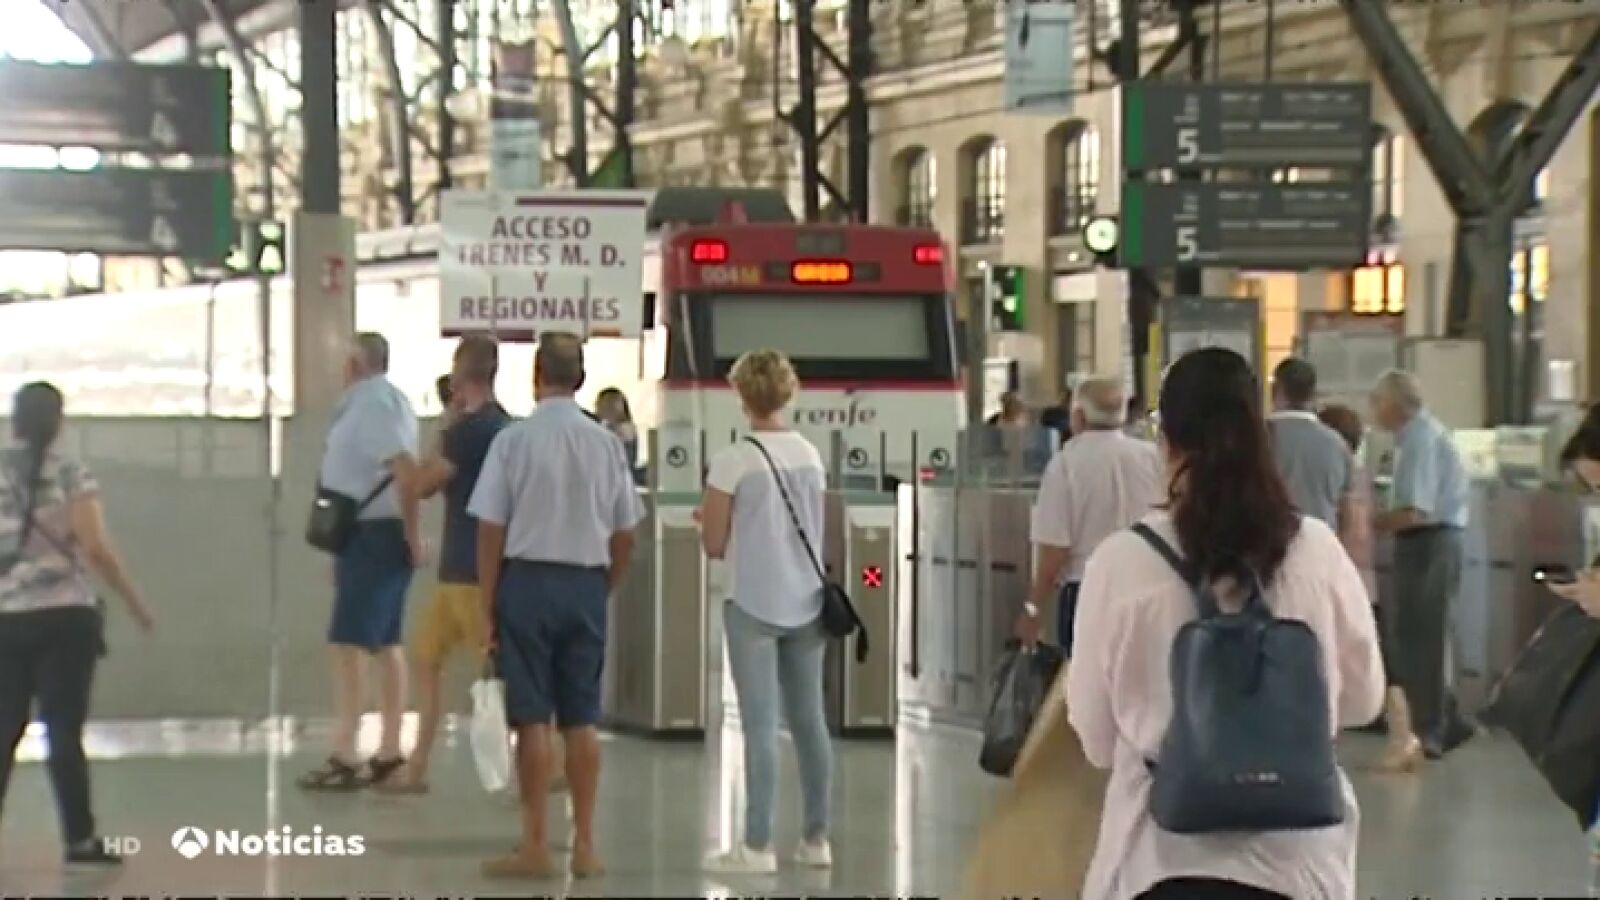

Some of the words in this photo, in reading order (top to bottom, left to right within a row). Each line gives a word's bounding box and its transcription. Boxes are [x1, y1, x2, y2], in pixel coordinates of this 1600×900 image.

[1176, 128, 1199, 163] 5
[492, 215, 592, 239] ACCESO
[561, 243, 590, 266] M.
[600, 243, 626, 267] D.
[1176, 226, 1198, 261] 5
[534, 271, 548, 293] Y
[460, 296, 620, 320] REGIONALES
[794, 399, 878, 427] renfe
